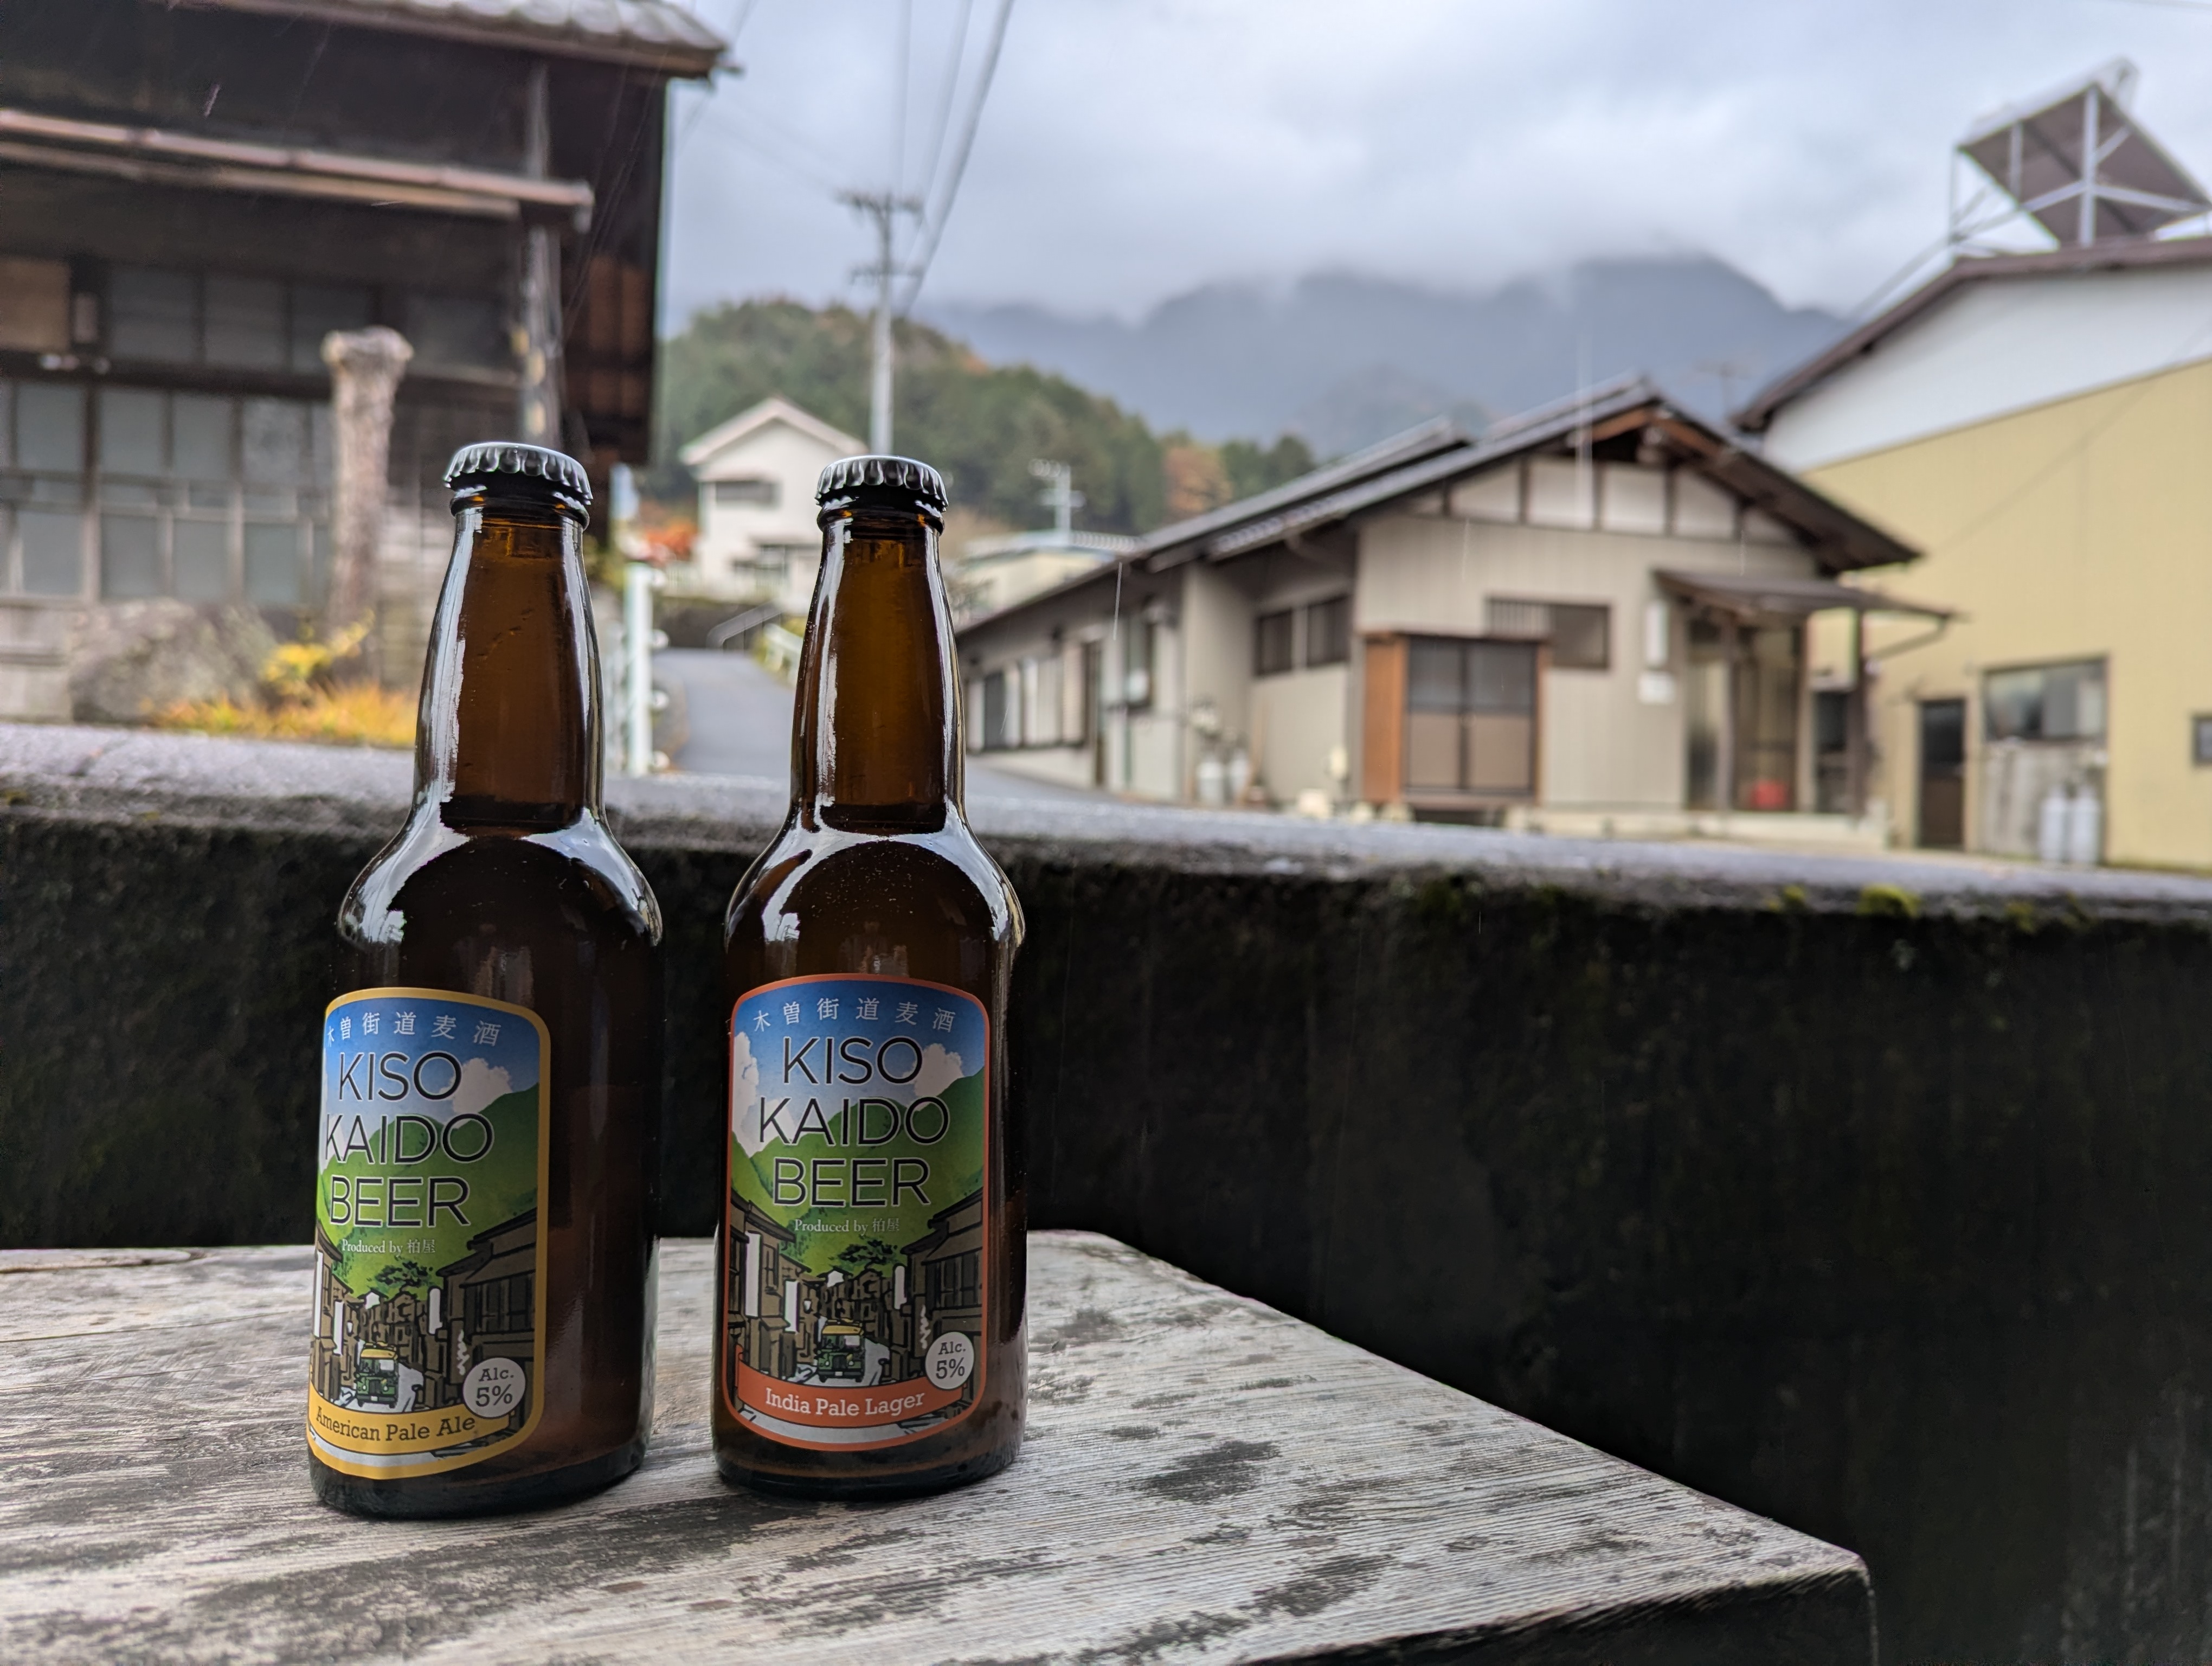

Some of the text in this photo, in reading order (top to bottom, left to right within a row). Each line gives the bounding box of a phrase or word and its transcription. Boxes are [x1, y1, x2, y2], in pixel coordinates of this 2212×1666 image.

[753, 998, 956, 1033] 木曽街道麦酒
[338, 1050, 462, 1101] KISO
[782, 1036, 923, 1085] KISO
[325, 1112, 494, 1165] KAIDO
[759, 1095, 950, 1147] KAIDO
[773, 1157, 931, 1208] BEER
[330, 1175, 471, 1228] BEER
[794, 1219, 850, 1232] Produced
[853, 1220, 868, 1236] by
[342, 1239, 385, 1253] Produced
[389, 1240, 403, 1257] by
[938, 1341, 966, 1355] Alc.
[479, 1368, 514, 1382] Alc.
[935, 1357, 965, 1379] 5%
[475, 1383, 513, 1407] 5%
[766, 1388, 925, 1416] India Pale Lager
[316, 1406, 475, 1441] American Pale Ale
